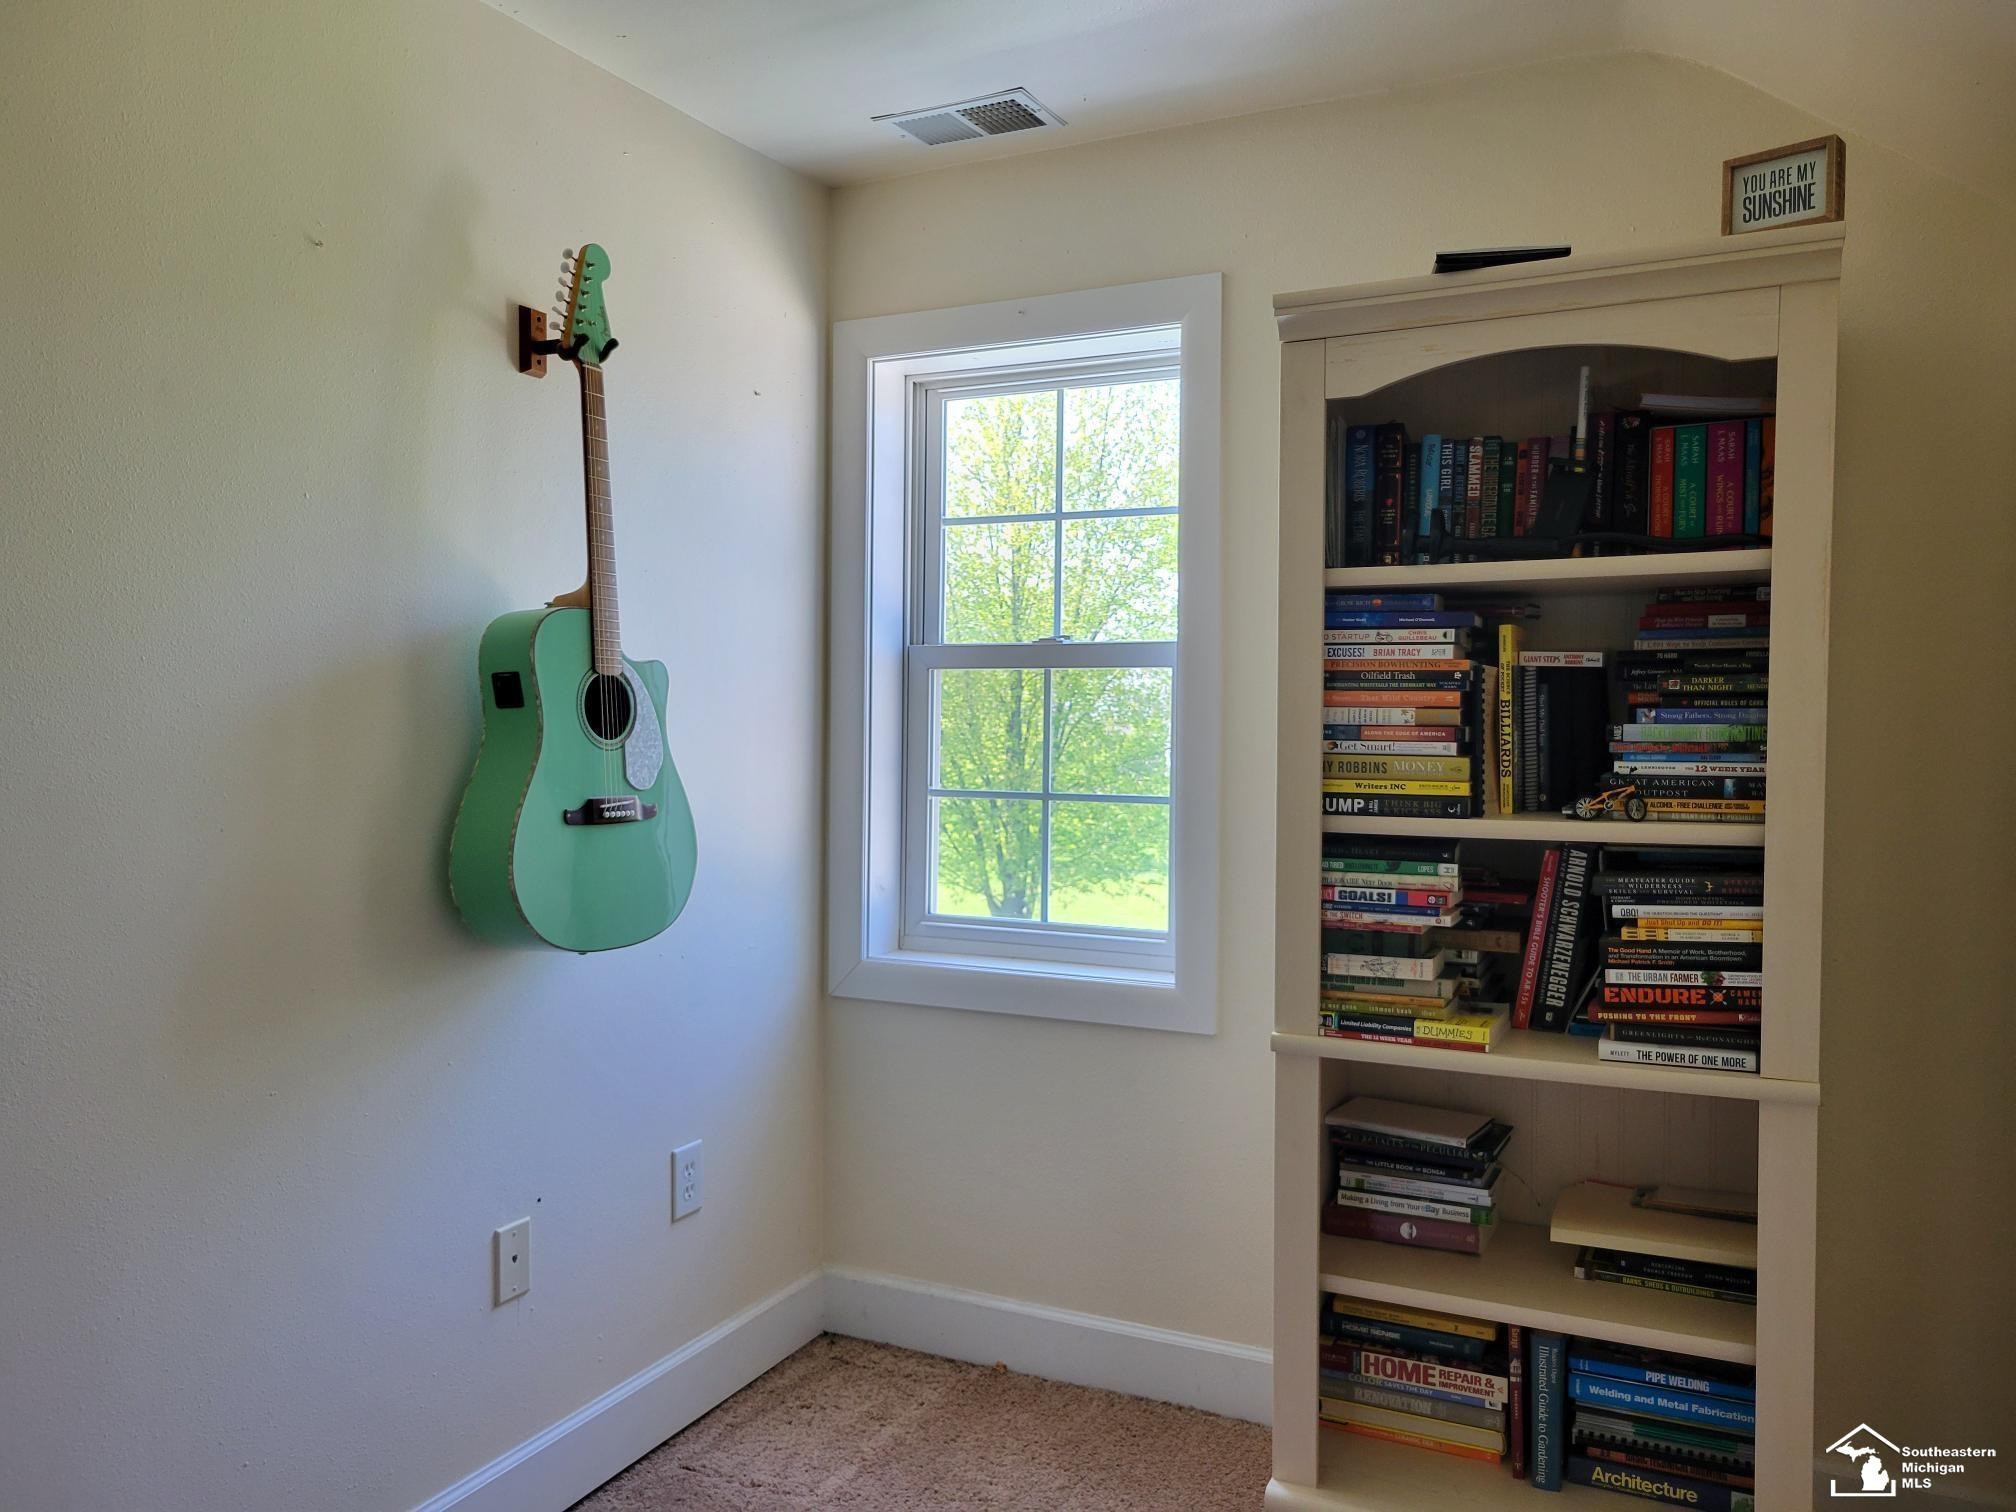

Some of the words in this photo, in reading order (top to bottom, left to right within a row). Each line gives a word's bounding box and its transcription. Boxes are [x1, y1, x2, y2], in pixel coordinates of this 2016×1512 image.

[1742, 173, 1766, 194] YOU
[1770, 166, 1792, 190] ARE
[1797, 160, 1816, 183] MY
[1742, 182, 1816, 224] SUNSHINE
[1353, 444, 1368, 467] NORA
[1440, 442, 1453, 465] THIS
[1680, 440, 1689, 466] MAAS
[1691, 435, 1700, 464] SARAH
[1716, 438, 1726, 464] MAAS
[1728, 431, 1736, 460] SARAH
[1468, 445, 1481, 497] SLAMMED
[1483, 454, 1500, 472] THE
[1352, 469, 1368, 503] ROBERTS
[1440, 468, 1452, 491] GIRL
[1679, 478, 1688, 498] MIST
[1715, 474, 1725, 504] WINGS
[1527, 490, 1538, 515] FAMILY
[1688, 491, 1697, 520] COURT
[1726, 489, 1735, 520] COURT
[1678, 510, 1687, 531] FURY
[1328, 647, 1364, 658] EXCUSES!
[1373, 648, 1396, 657] BRIAN
[1398, 648, 1421, 657] TRACY
[1524, 655, 1542, 664] GIANT
[1543, 656, 1560, 664] STEPS
[1360, 672, 1392, 680] Oilfield
[1394, 672, 1416, 680] Trash
[1660, 712, 1683, 720] Strong
[1714, 712, 1737, 720] Strong
[1340, 742, 1358, 751] Get
[1360, 742, 1396, 752] Smart!
[1500, 700, 1511, 778] BILLIARDS
[1338, 761, 1388, 774] ROBBINS
[1392, 760, 1444, 772] MONEY
[1695, 764, 1708, 772] 12
[1354, 782, 1388, 790] Writers
[1652, 778, 1715, 787] AMERICAN
[1324, 798, 1365, 813] UMP
[1418, 864, 1434, 873] LOPES
[1563, 850, 1588, 898] ARNOLD
[1338, 890, 1392, 902] GOALS!
[1537, 876, 1551, 918] SHOOTER'S
[1340, 912, 1363, 920] SWITCH
[1532, 920, 1543, 940] BIBLE
[1528, 942, 1539, 966] GUIDE
[1545, 900, 1580, 1008] SCHWARZENEGGER
[1526, 968, 1534, 978] TO
[1628, 972, 1642, 982] THE
[1643, 972, 1668, 982] URBAN
[1670, 973, 1699, 983] FARMER
[1604, 986, 1706, 1005] ENDURE
[1360, 1021, 1382, 1030] Liability
[1382, 1023, 1412, 1032] Companies
[1422, 1026, 1472, 1040] DUMMIES
[1636, 1050, 1652, 1061] THE
[1655, 1052, 1686, 1063] POWER
[1688, 1054, 1698, 1064] OF
[1702, 1055, 1718, 1066] ONE
[1721, 1056, 1747, 1068] MORE
[1422, 1166, 1446, 1175] BONSAI
[1341, 1194, 1364, 1204] Making
[1370, 1196, 1388, 1208] Living
[1390, 1200, 1404, 1208] from
[1406, 1202, 1420, 1210] Your
[1442, 1207, 1469, 1218] Business
[1644, 1280, 1664, 1290] SHEDS
[1364, 1354, 1436, 1387] HOME
[1439, 1370, 1482, 1386] REPAIR
[1484, 1378, 1495, 1389] &
[1538, 1344, 1550, 1392] Illustrated
[1384, 1382, 1404, 1391] SAVES
[1404, 1384, 1418, 1393] THE
[1418, 1386, 1433, 1397] DAY
[1438, 1381, 1496, 1398] IMPROVEMENT
[1646, 1370, 1666, 1385] PIPE
[1668, 1374, 1710, 1392] WELDING
[1538, 1393, 1549, 1422] Guide
[1588, 1384, 1631, 1402] Welding
[1634, 1394, 1654, 1406] and
[1657, 1397, 1689, 1412] Metal
[1691, 1403, 1756, 1424] Fabrication
[1538, 1424, 1548, 1434] to
[1536, 1434, 1549, 1484] Gardening
[1591, 1466, 1698, 1503] Architecture
